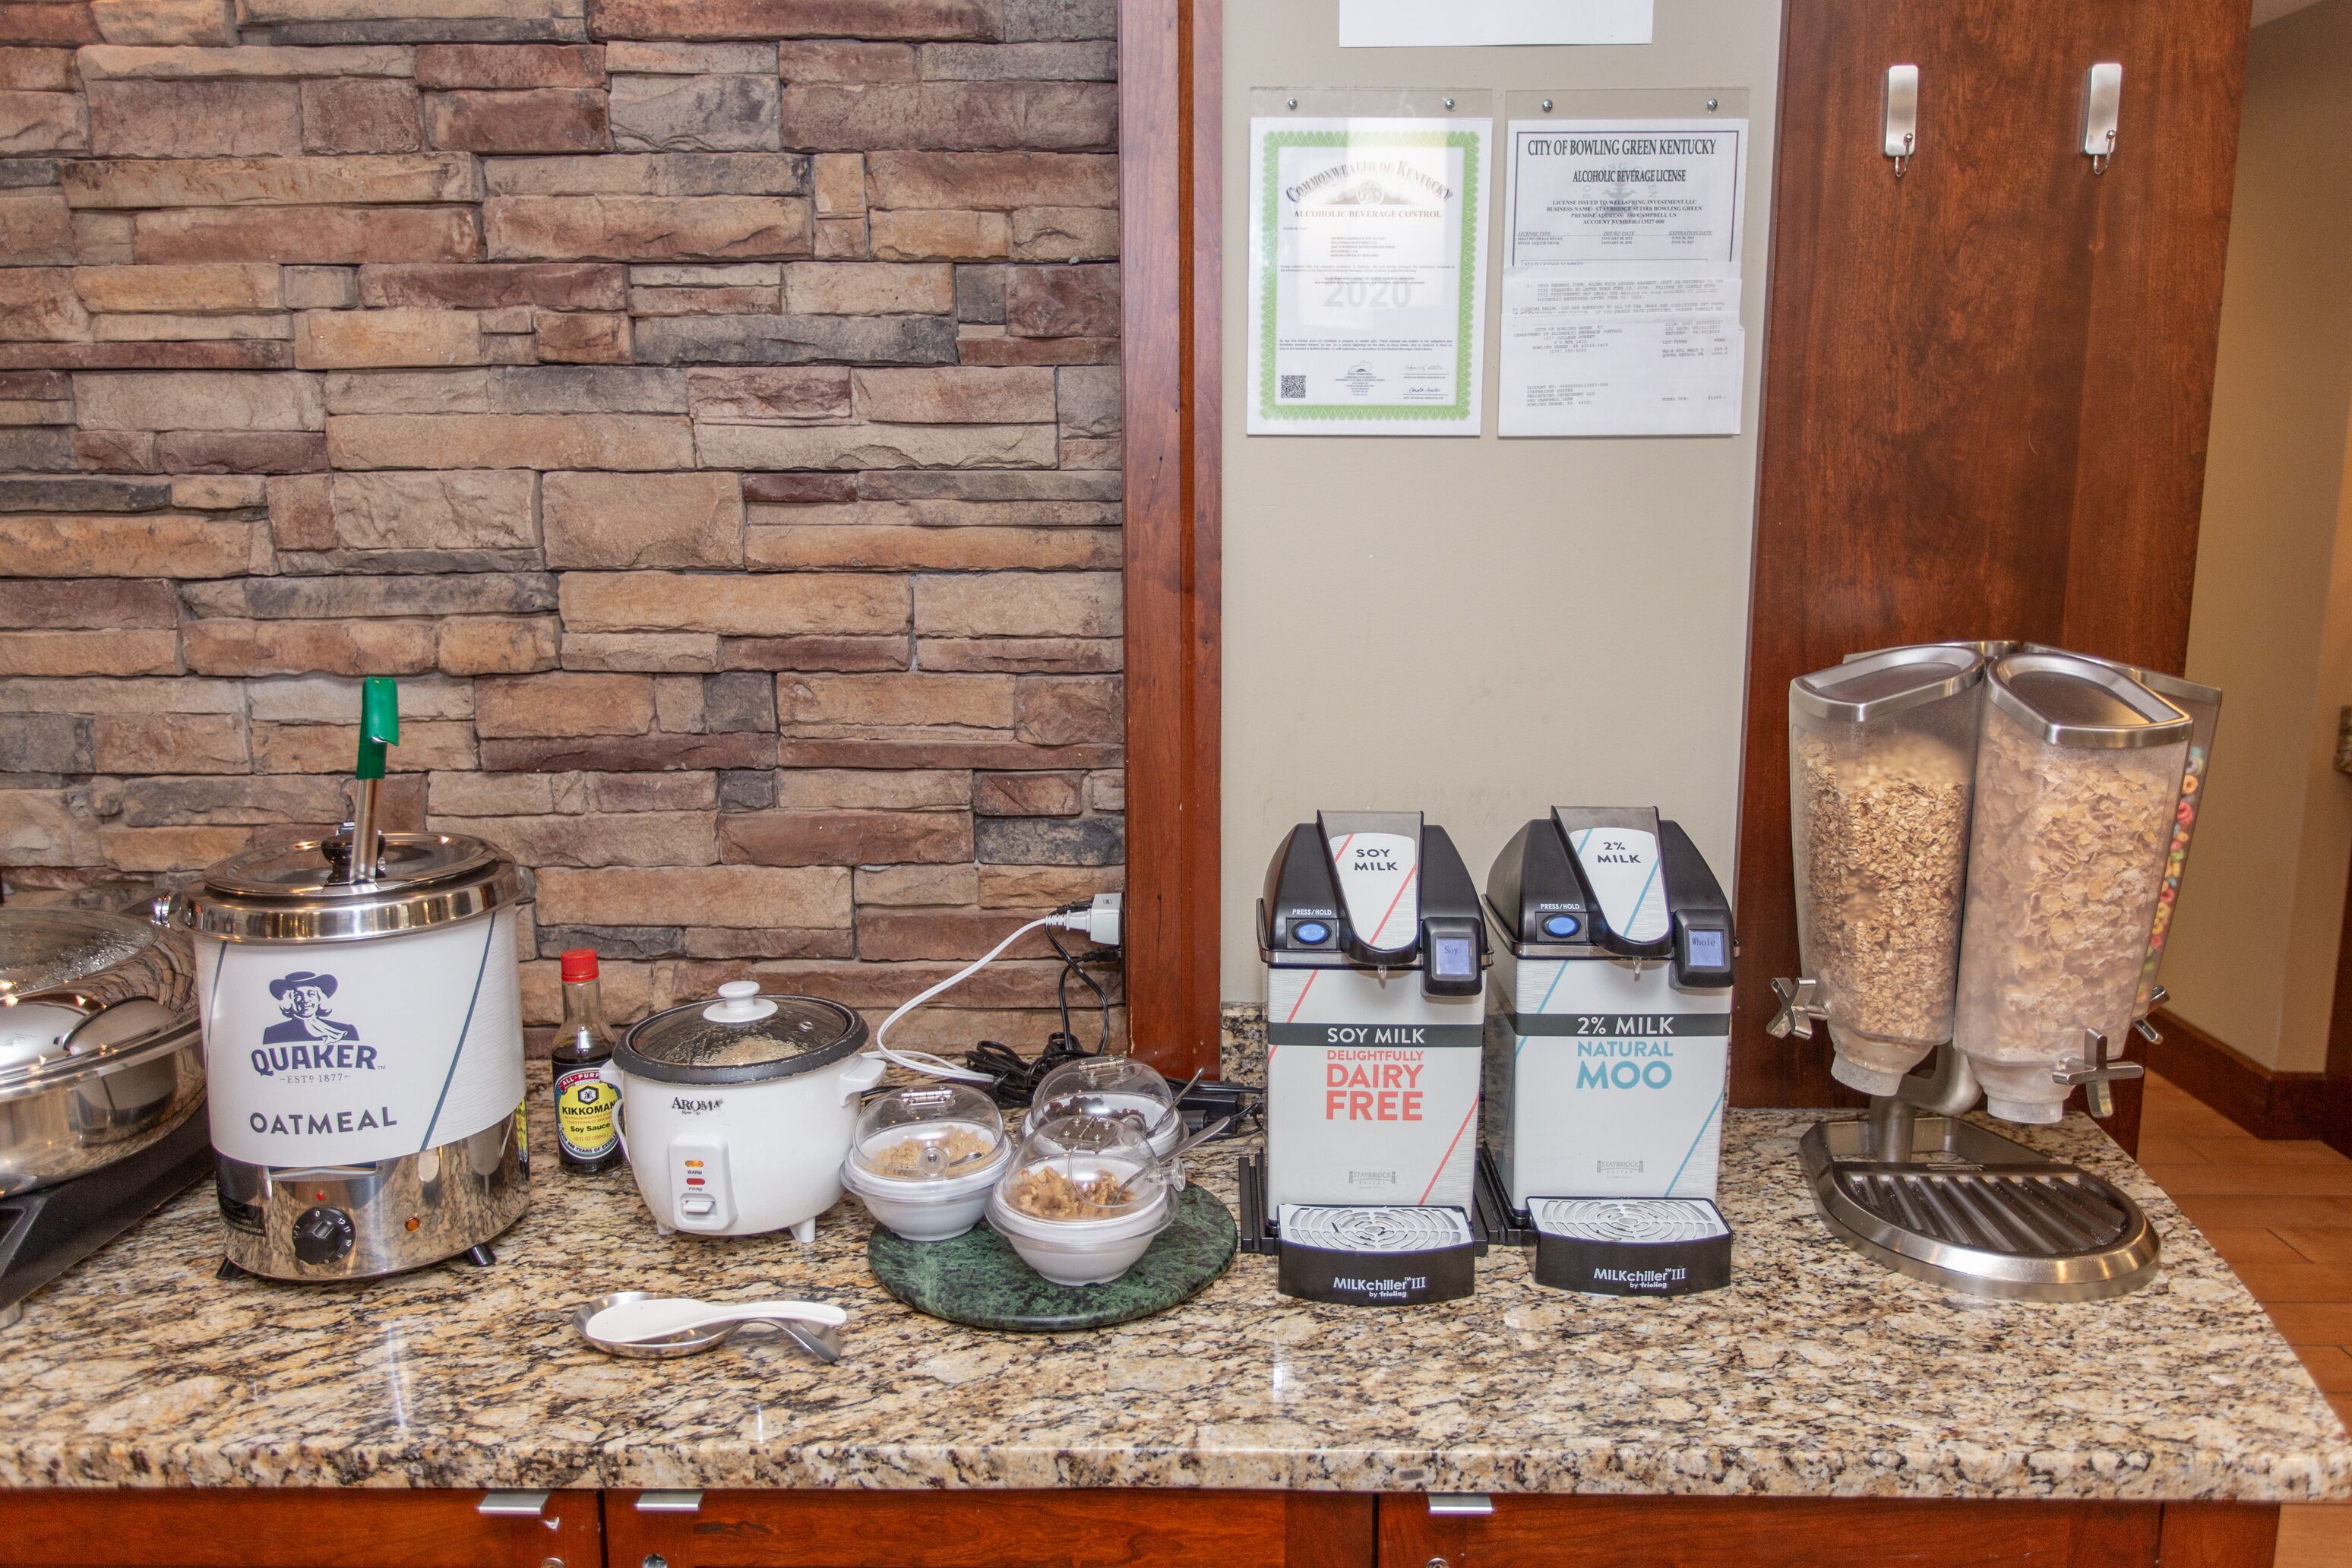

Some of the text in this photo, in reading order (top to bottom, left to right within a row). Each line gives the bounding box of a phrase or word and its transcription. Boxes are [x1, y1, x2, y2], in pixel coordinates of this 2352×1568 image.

[1528, 138, 1716, 156] CITY OF BOWLING GREEN KENTUCKY
[1573, 169, 1686, 183] ALCOHOLIC BEVERAGE LICENSE
[1348, 210, 1396, 218] BEVERAGE
[1398, 210, 1442, 218] CONTROL
[1355, 849, 1391, 858] SOY
[1603, 842, 1626, 851] 2%
[1354, 861, 1399, 871] MILK
[1597, 855, 1641, 864] MILK
[1691, 937, 1715, 947] Whole
[1443, 946, 1459, 955] Soy
[1576, 1016, 1674, 1035] 2% MILK
[1327, 1027, 1425, 1044] SOY MILK
[1326, 1049, 1424, 1061] DELIGHTFULLY
[1576, 1041, 1674, 1057] NATURAL
[251, 1044, 378, 1076] QUAKER
[1326, 1063, 1424, 1089] DAIRY
[1576, 1060, 1673, 1089] MOO
[561, 1100, 616, 1115] KIKKOMAN
[1326, 1089, 1424, 1121] FREE
[249, 1105, 398, 1135] OATMEAL
[586, 1123, 611, 1132] Sauce
